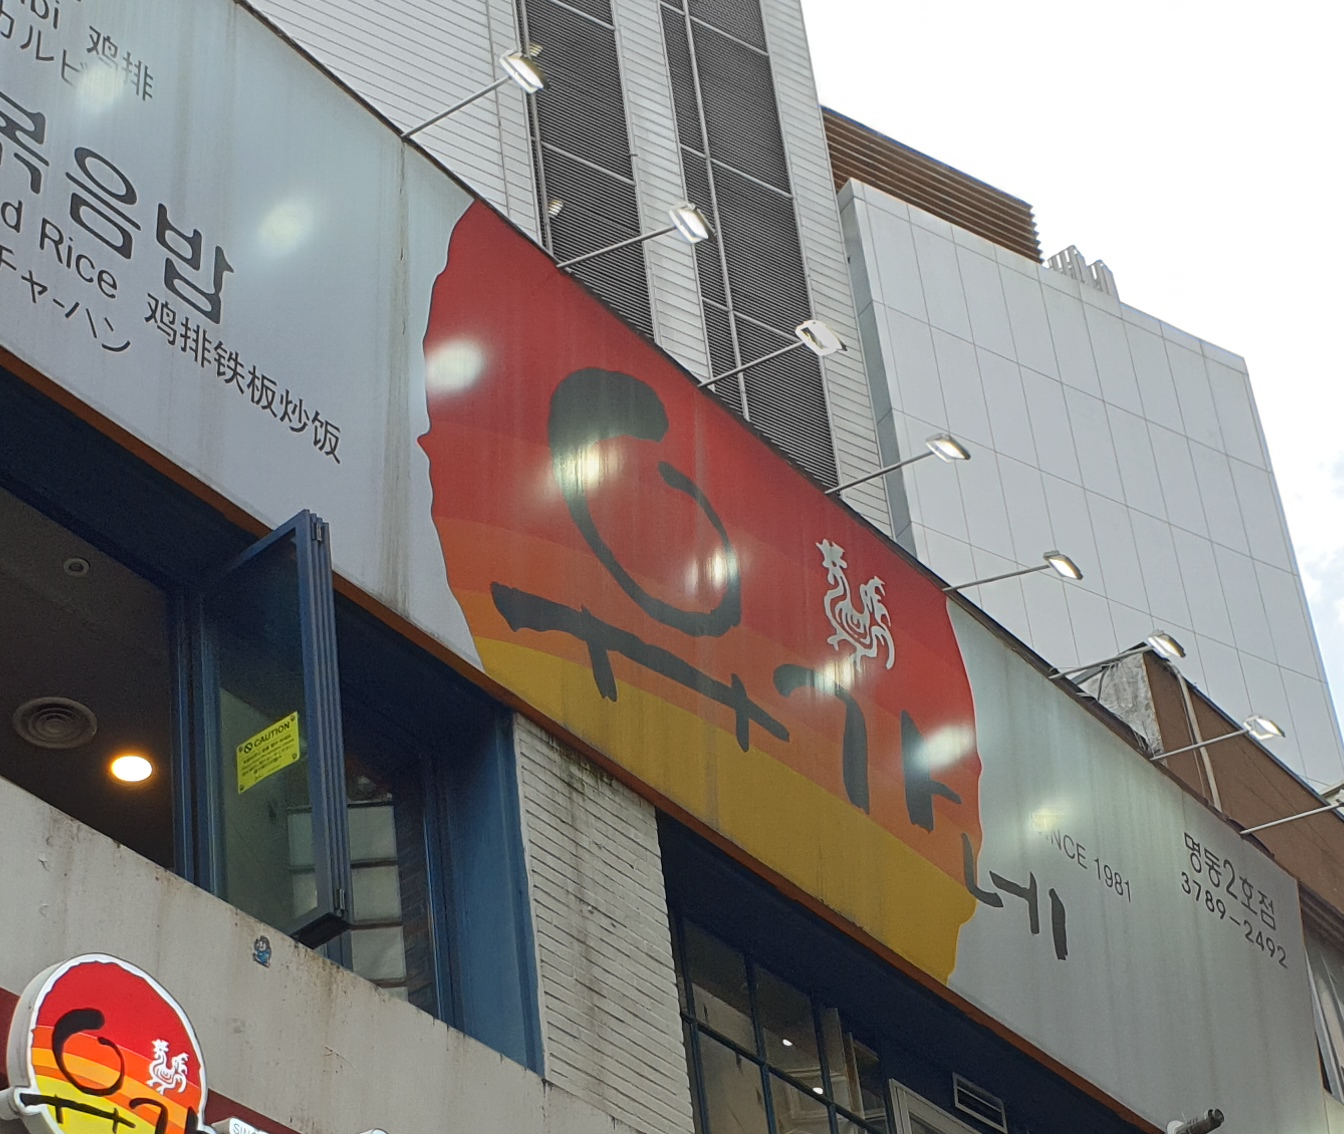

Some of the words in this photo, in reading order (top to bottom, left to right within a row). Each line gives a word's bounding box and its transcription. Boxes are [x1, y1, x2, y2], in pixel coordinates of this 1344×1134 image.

[39, 217, 121, 301] Rice
[145, 292, 344, 467] 鸡排铁板炒饭
[489, 367, 1069, 962] 유가네
[253, 722, 291, 748] CAUTION
[1093, 857, 1132, 903] 1981
[1180, 871, 1289, 970] 3789-2492
[1183, 831, 1278, 932] 명동2호점
